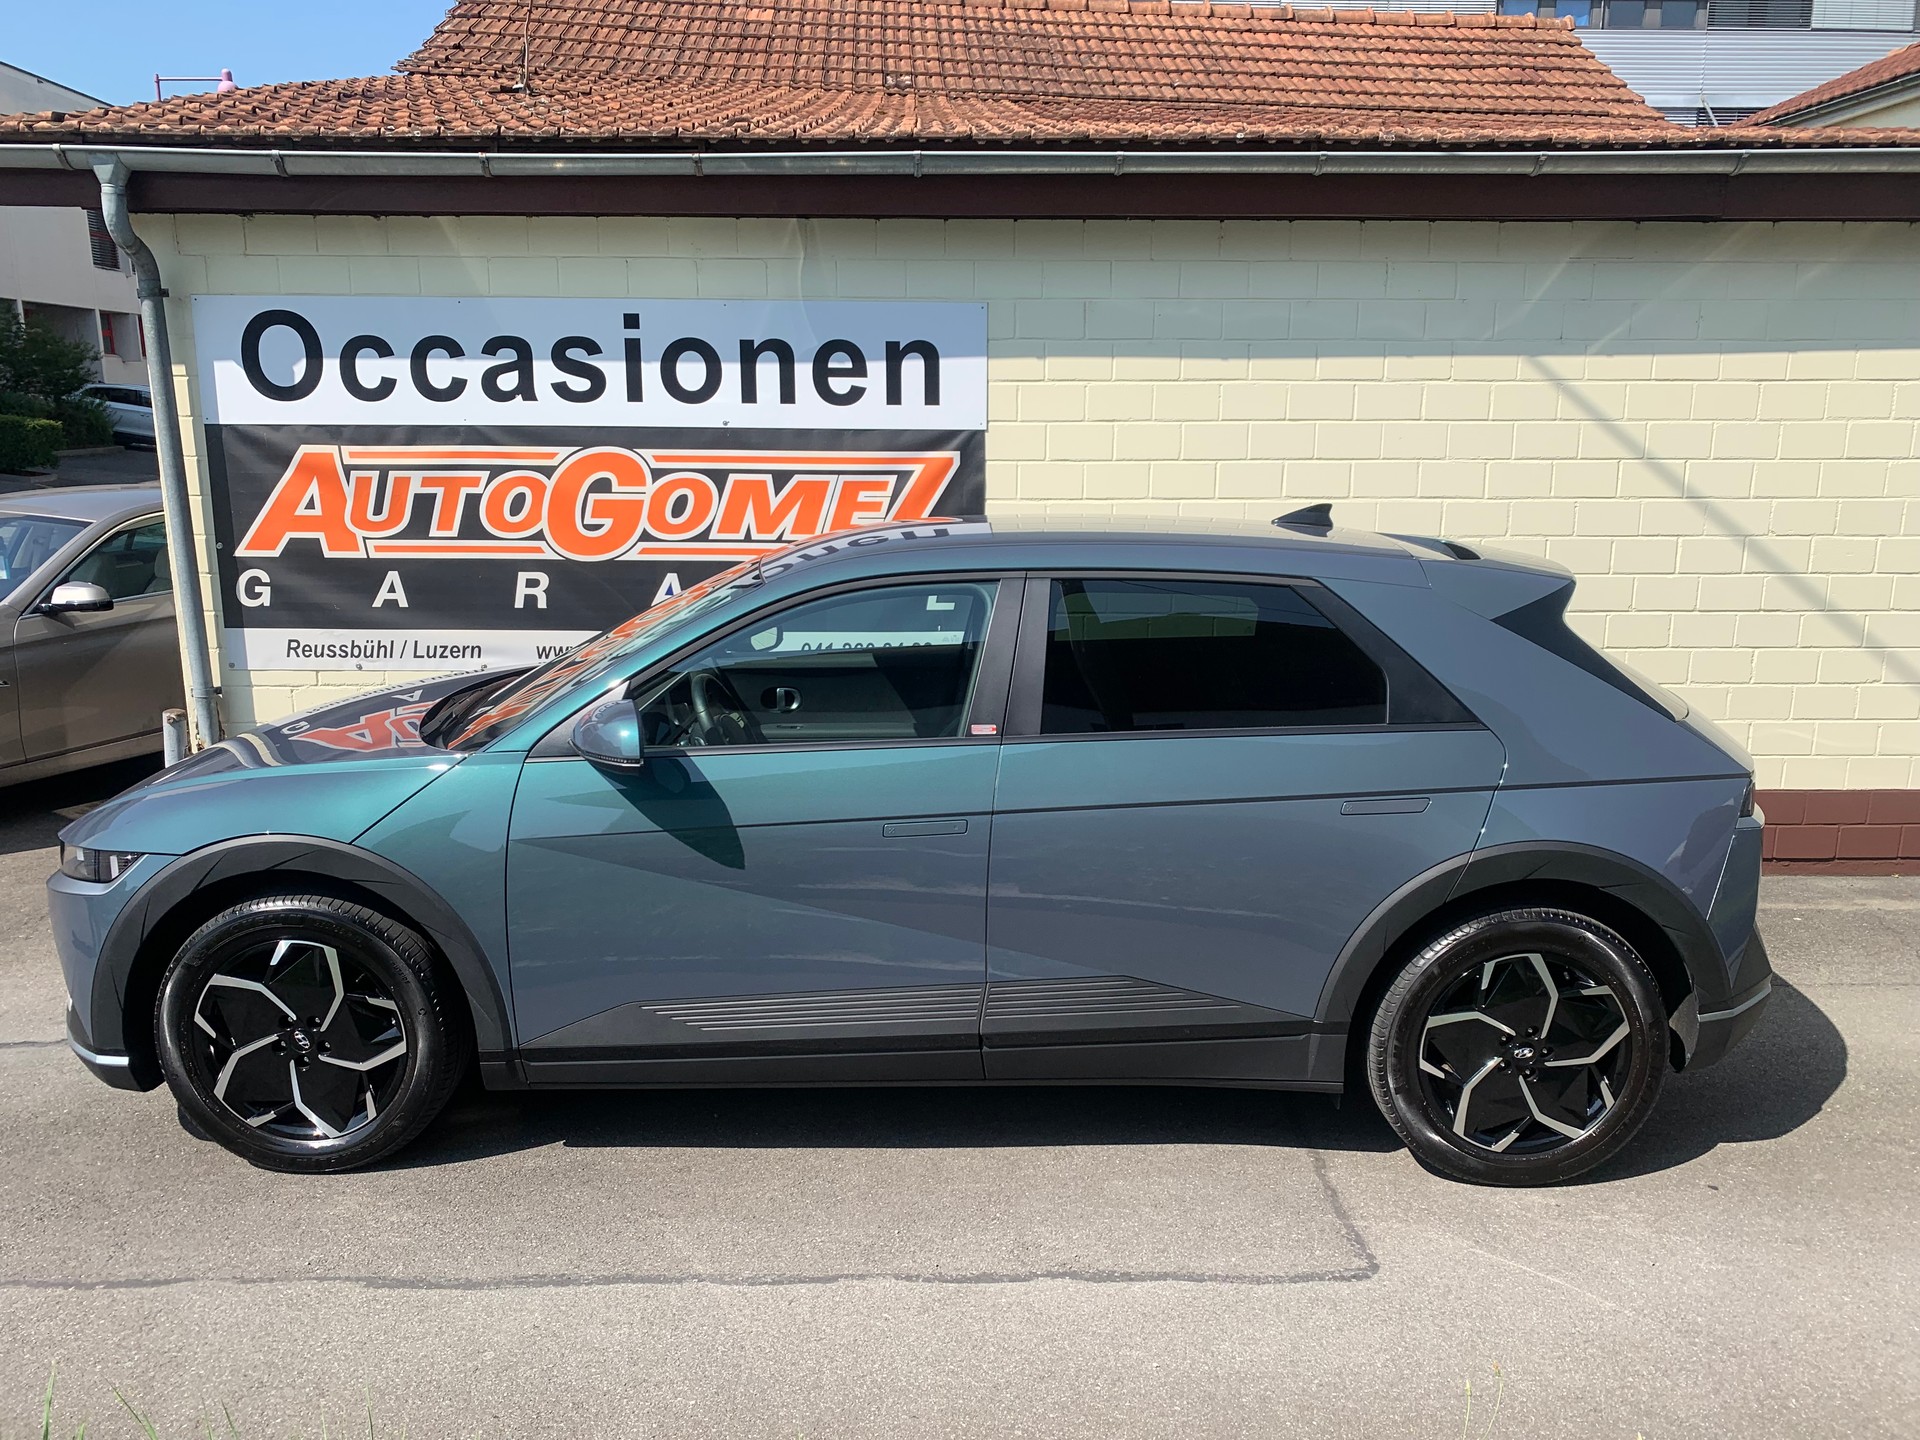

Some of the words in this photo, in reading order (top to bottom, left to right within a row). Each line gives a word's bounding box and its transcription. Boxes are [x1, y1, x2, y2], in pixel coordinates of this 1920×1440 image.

[240, 309, 941, 407] Occasionen
[286, 638, 394, 659] Reussbühl
[413, 640, 482, 659] Luzern
